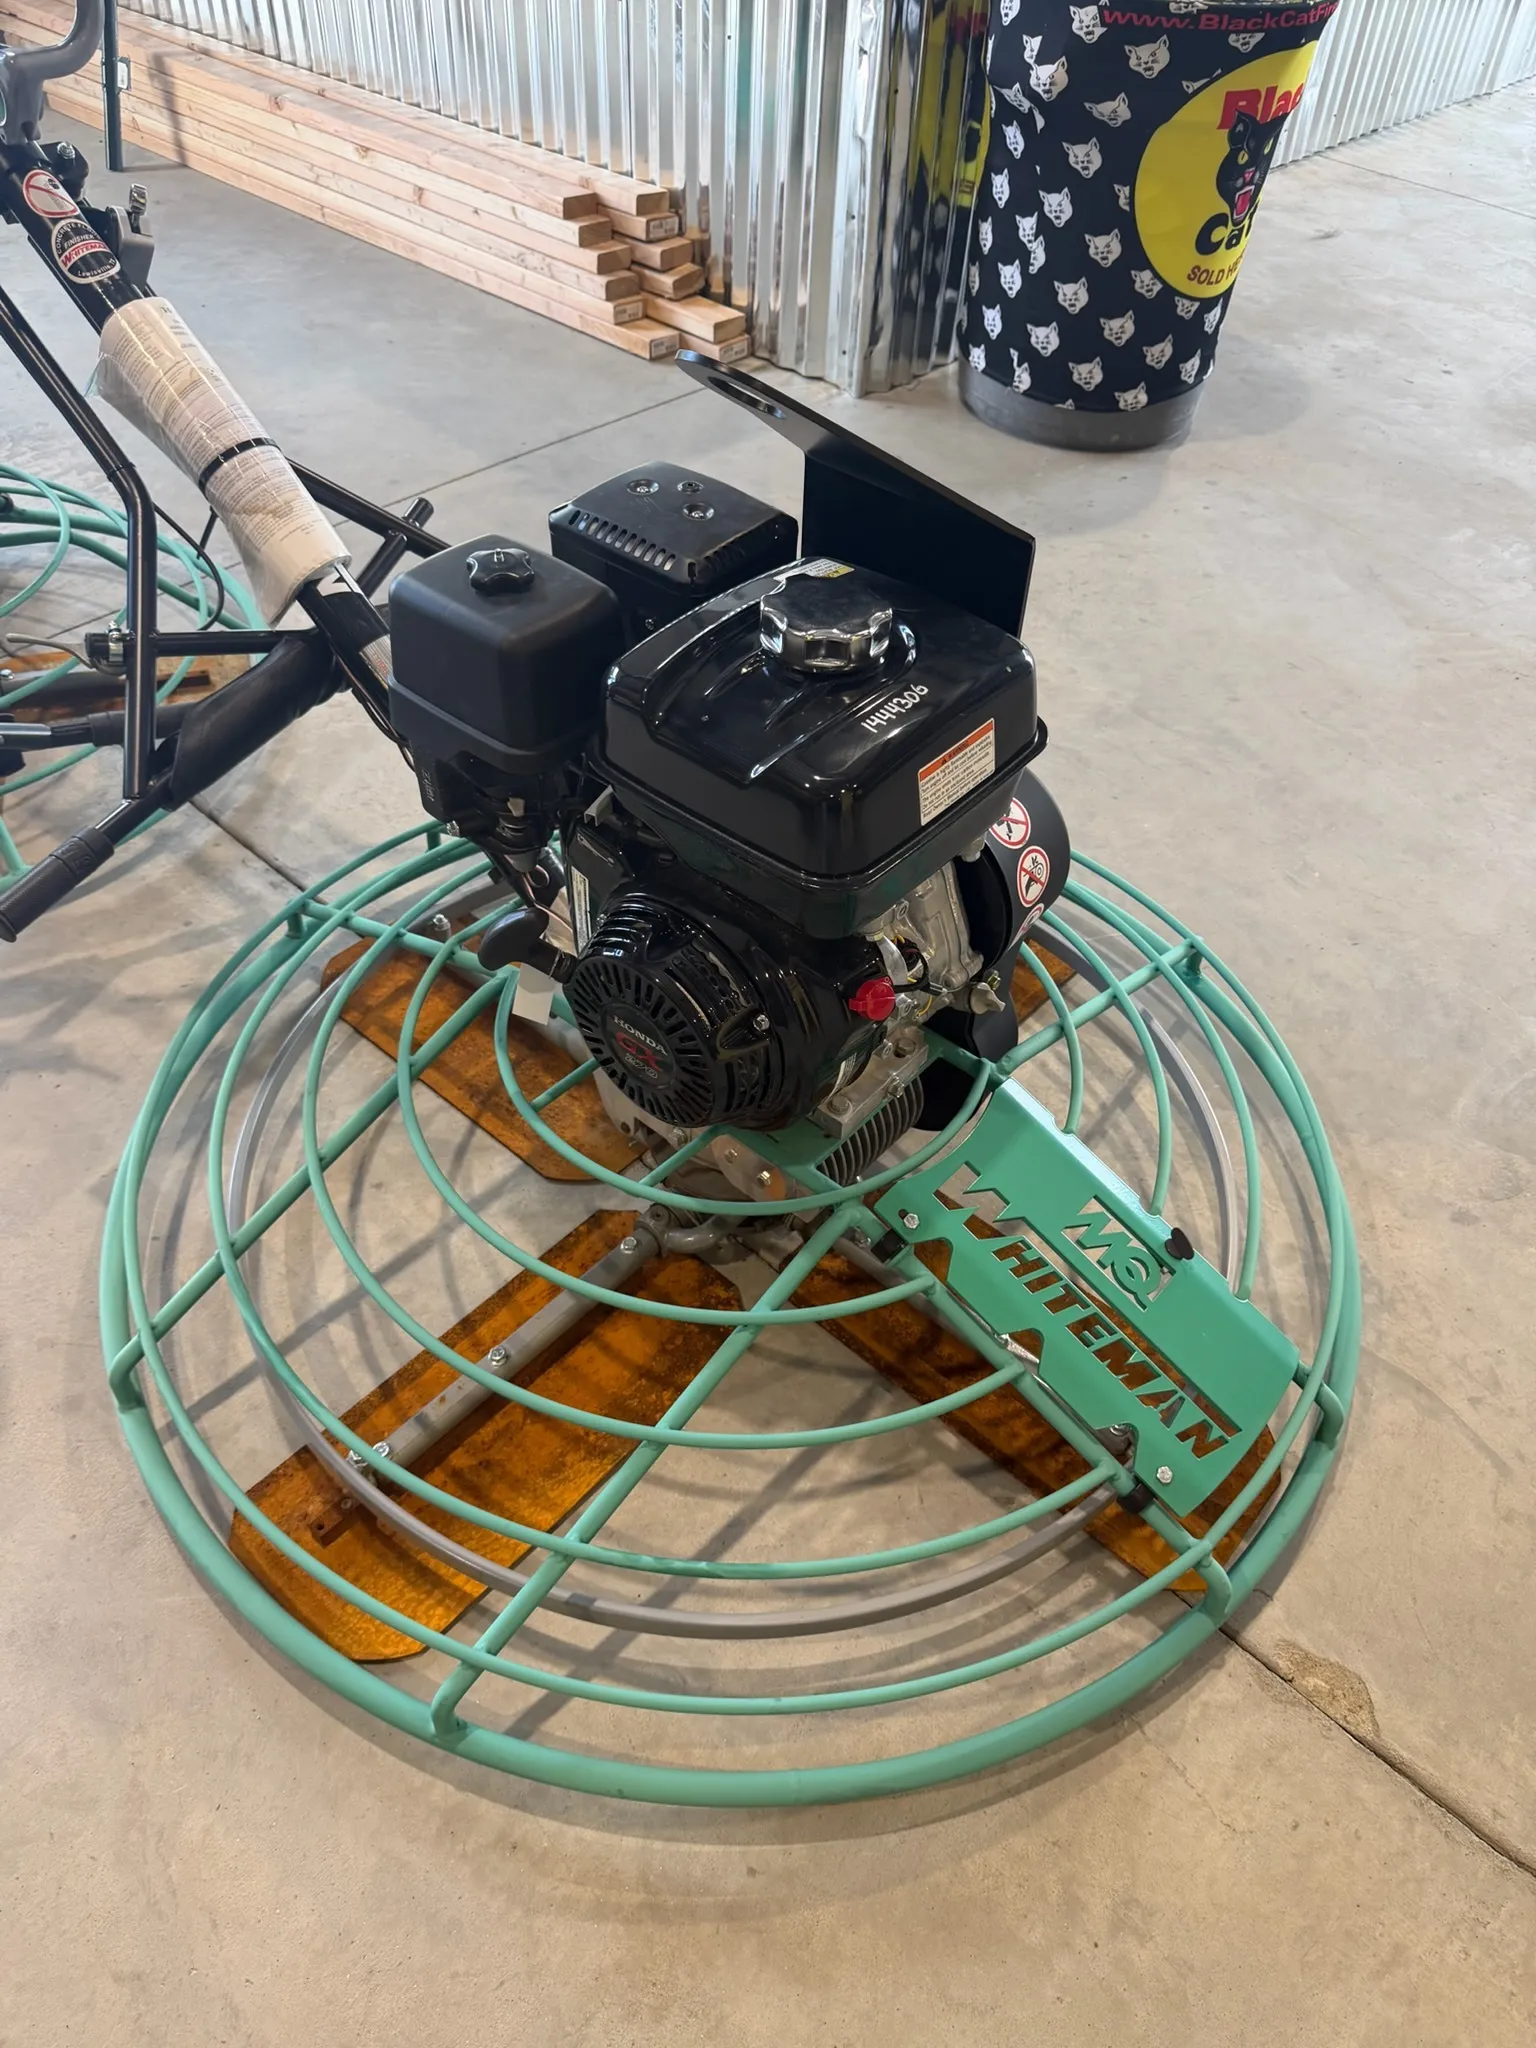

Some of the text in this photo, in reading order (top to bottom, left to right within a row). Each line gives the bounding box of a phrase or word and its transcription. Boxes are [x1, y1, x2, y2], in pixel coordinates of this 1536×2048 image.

[56, 222, 77, 255] CONCRETE
[64, 233, 95, 249] FINISHER
[1186, 265, 1226, 286] SOLD
[861, 684, 929, 733] 1444306
[613, 1015, 668, 1056] HONDA
[615, 1032, 664, 1072] GX
[932, 1161, 1243, 1460] WHITEMAN
